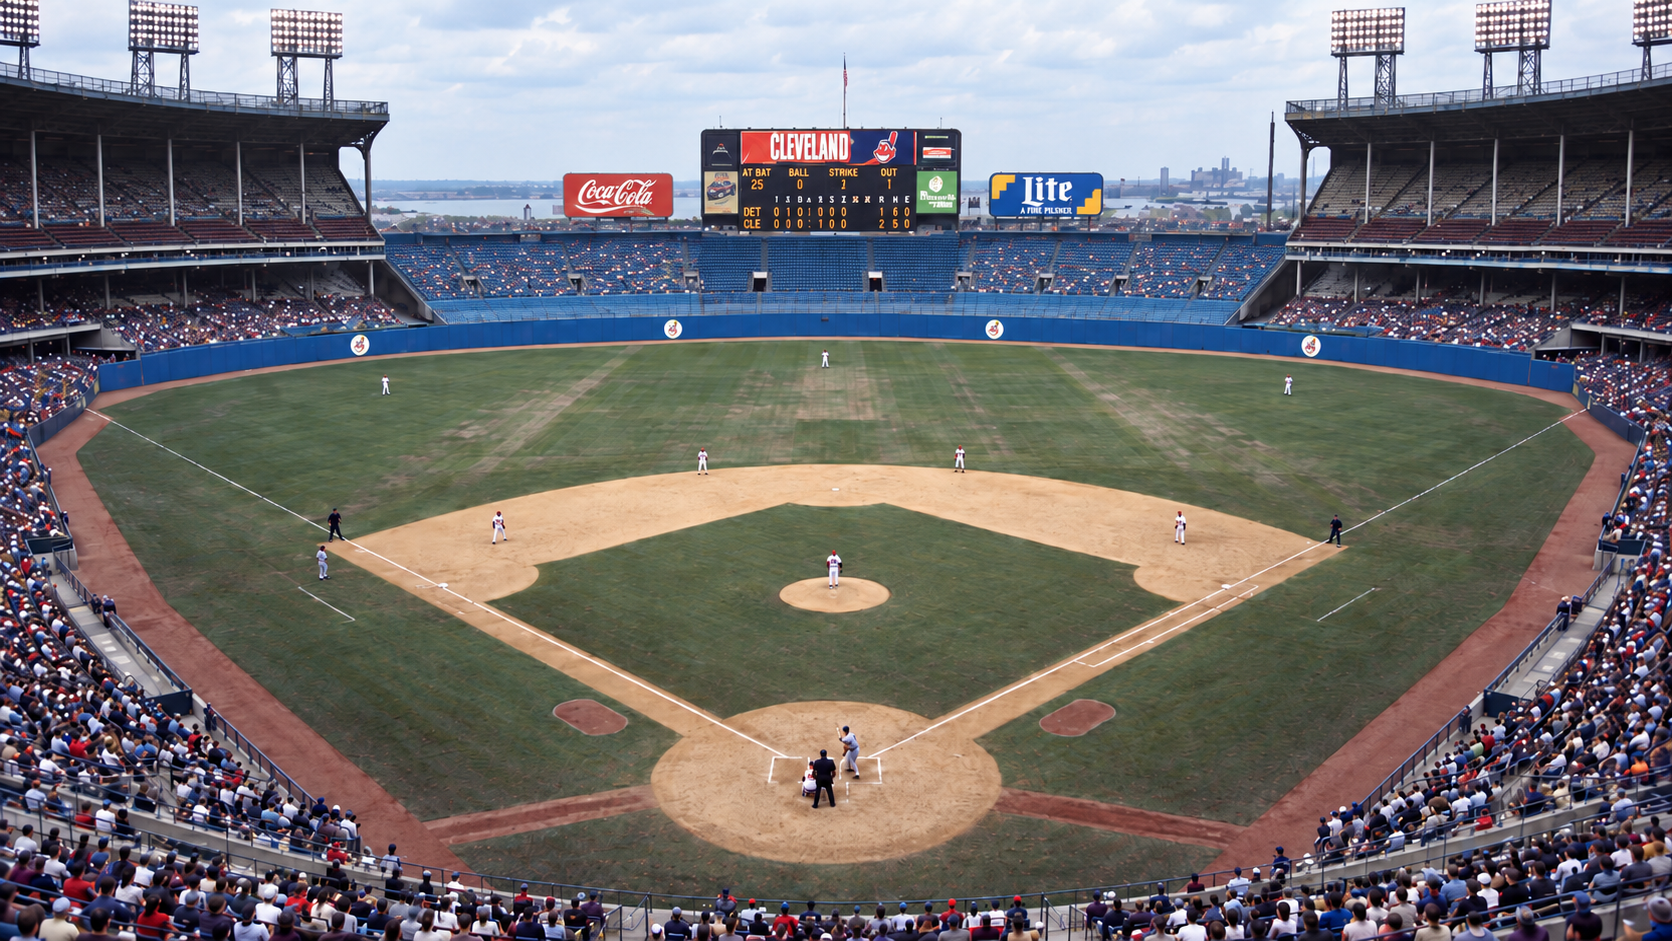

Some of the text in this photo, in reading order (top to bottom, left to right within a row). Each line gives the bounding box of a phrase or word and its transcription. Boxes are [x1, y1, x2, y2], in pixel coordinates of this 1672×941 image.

[770, 133, 849, 161] CLEVELAND
[742, 168, 898, 177] AT BAT BALL STRIKE OUT
[750, 179, 764, 190] 25
[796, 179, 803, 190] 0
[887, 179, 892, 190] 1
[577, 179, 657, 206] Coca-Cola
[1021, 176, 1073, 207] Lite
[878, 196, 885, 204] R
[904, 196, 911, 204] E
[743, 207, 762, 217] DET
[773, 207, 780, 217] 0
[786, 207, 791, 217] 1
[797, 207, 804, 217] 0
[817, 207, 824, 217] 0
[829, 207, 835, 217] 0
[841, 207, 847, 217] 0
[879, 207, 884, 217] 1
[892, 207, 899, 217] 6
[904, 207, 911, 217] 0
[1020, 207, 1026, 215] A
[743, 219, 762, 229] CLE
[773, 219, 780, 229] 0
[785, 219, 792, 229] 0
[797, 219, 804, 229] 0
[818, 219, 823, 229] 1
[829, 219, 835, 229] 0
[841, 219, 847, 229] 0
[878, 219, 885, 229] 2
[904, 219, 911, 229] 0
